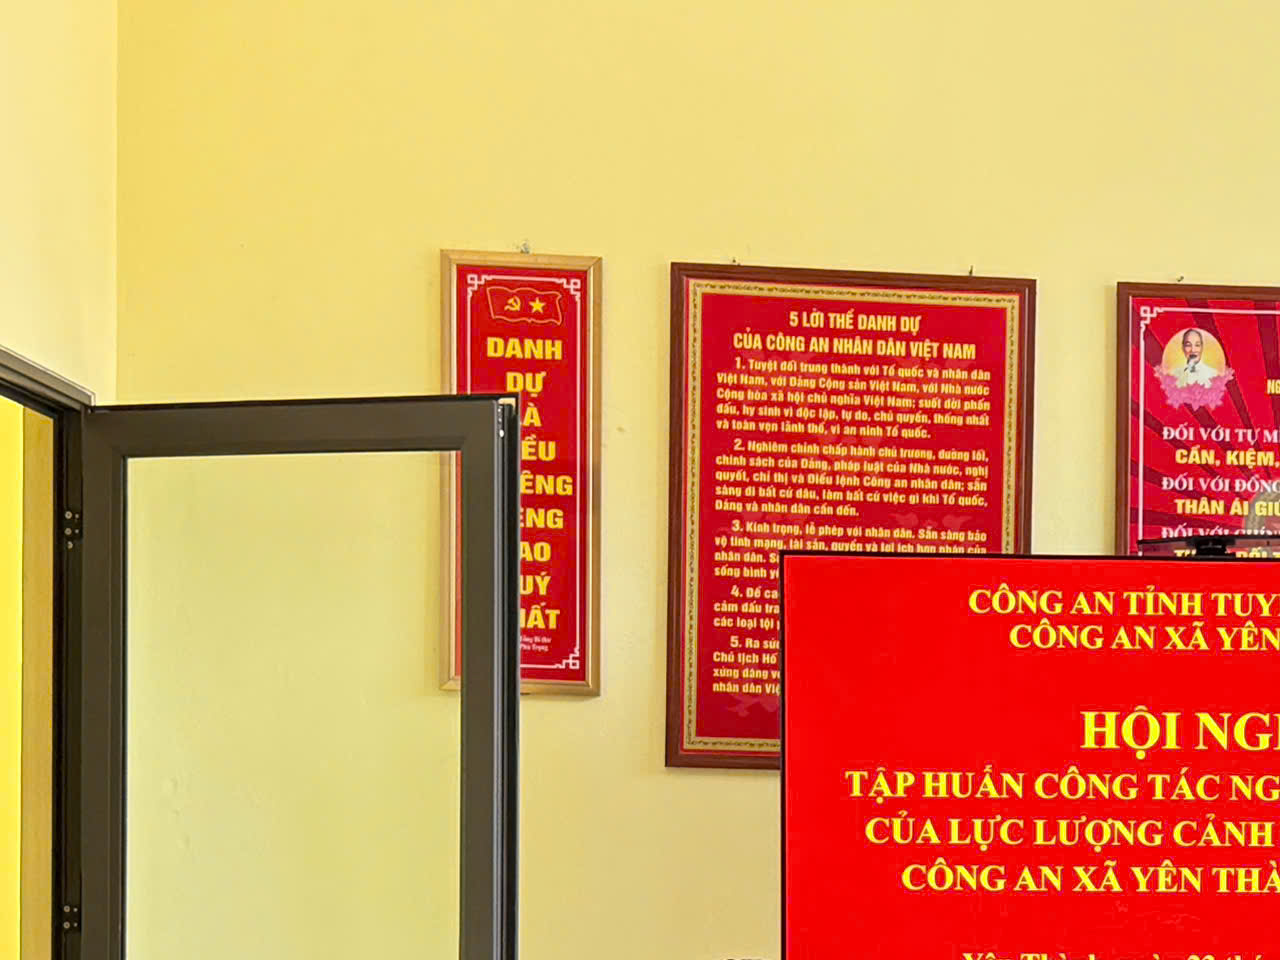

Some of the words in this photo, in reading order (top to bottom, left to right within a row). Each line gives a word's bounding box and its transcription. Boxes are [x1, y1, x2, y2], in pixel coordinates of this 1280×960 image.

[789, 311, 798, 326] 5
[858, 314, 896, 331] DANH
[900, 316, 921, 335] DỰ
[487, 337, 562, 361] DANH
[734, 328, 762, 349] CỦA
[766, 332, 804, 351] CÔNG
[809, 337, 828, 352] AN
[833, 336, 872, 354] NHÂN
[876, 337, 905, 356] DÂN
[910, 339, 939, 359] VIỆT
[943, 343, 975, 359] NAM
[506, 370, 546, 397] DỰ
[520, 402, 542, 427] À
[1163, 423, 1194, 441] ĐỐI
[1200, 424, 1230, 442] VỚI
[1236, 428, 1259, 444] TỰ
[521, 433, 556, 462] ỀU
[1226, 449, 1279, 468] KIỆM,
[520, 470, 573, 496] ÊNG
[1162, 473, 1193, 491] ĐỐI
[1200, 475, 1230, 492] VỚI
[1175, 497, 1224, 515] THÂN
[1230, 498, 1249, 516] ÁI
[520, 541, 552, 562] AO
[520, 571, 551, 595] UÝ
[969, 583, 1062, 614] CÔNG
[1070, 591, 1114, 614] AN
[1123, 585, 1202, 615] TỈNH
[730, 635, 742, 648] 5.
[1010, 620, 1103, 648] CÔNG
[1111, 626, 1155, 649] AN
[1164, 622, 1208, 649] XÃ
[1216, 622, 1280, 650] YÊN
[1080, 705, 1180, 758] HỘI
[845, 767, 914, 802] TẬP
[922, 765, 1024, 798] HUẤN
[1034, 766, 1138, 799] CÔNG
[1147, 767, 1219, 800] TÁC
[865, 810, 940, 843] CỦA
[949, 815, 1023, 851] LỰC
[1034, 816, 1162, 852] LƯỢNG
[1173, 813, 1274, 846] CẢNH
[902, 857, 1006, 890] CÔNG
[1013, 866, 1062, 890] AN
[1073, 860, 1122, 891] XÃ
[1131, 859, 1202, 892] YÊN
